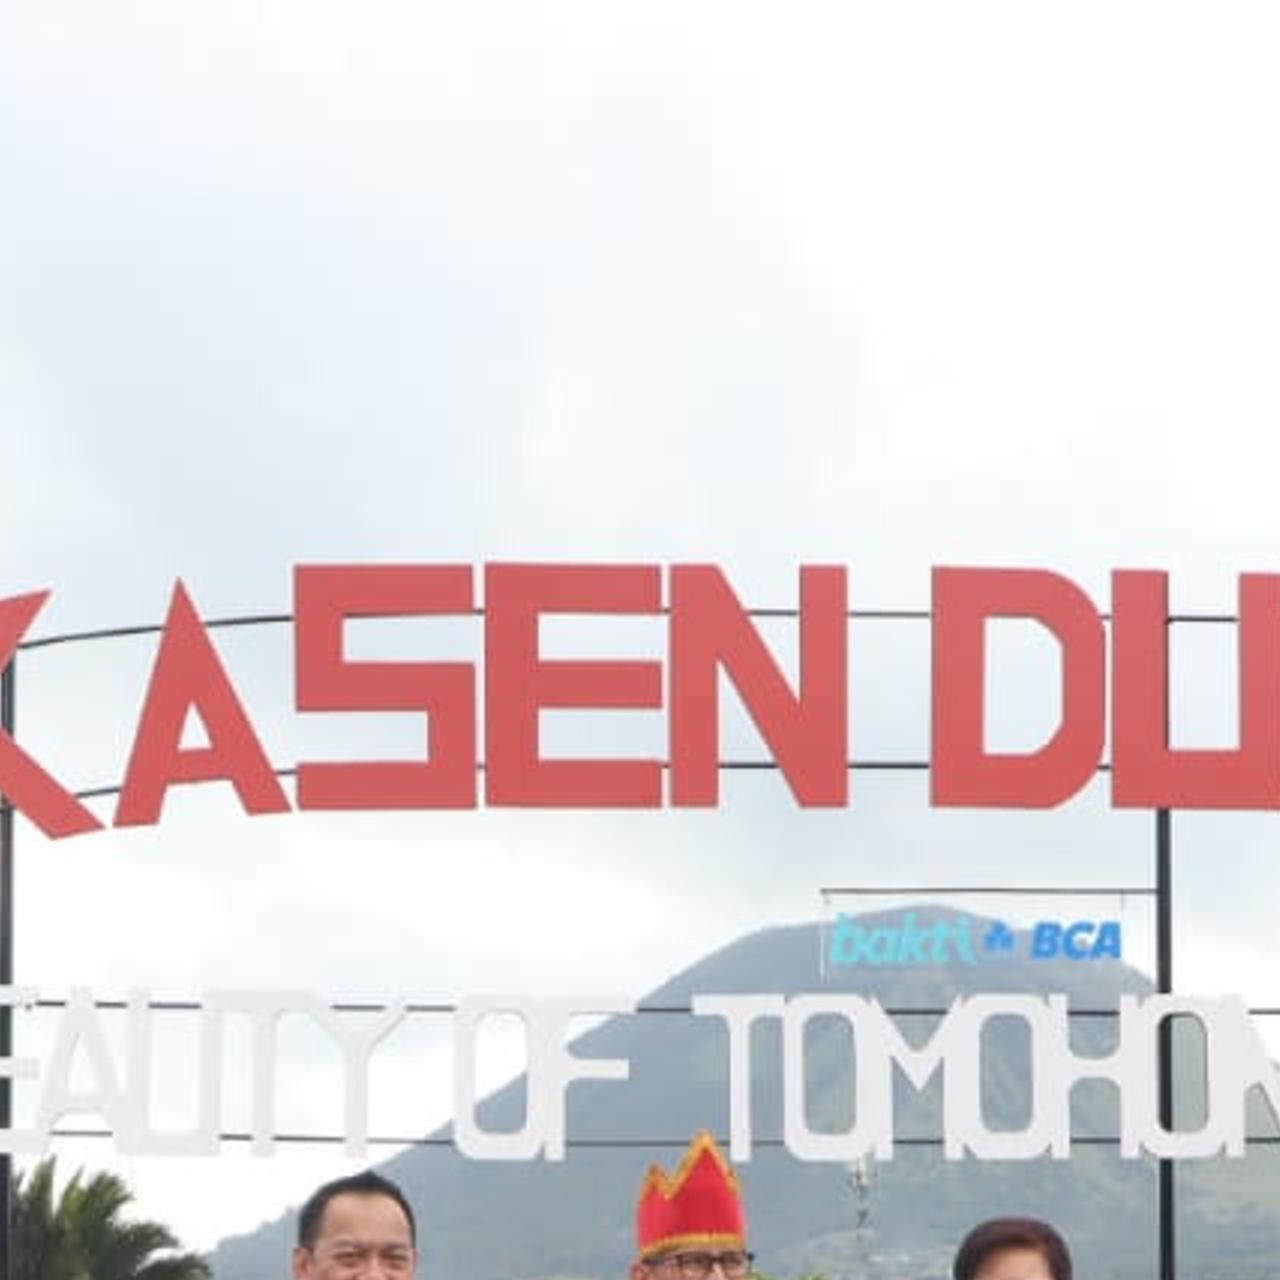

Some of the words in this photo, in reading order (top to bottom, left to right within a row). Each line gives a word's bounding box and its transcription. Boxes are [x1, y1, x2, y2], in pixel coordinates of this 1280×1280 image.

[830, 911, 976, 965] bakti
[1031, 920, 1122, 959] BCA
[452, 995, 642, 1161] OF
